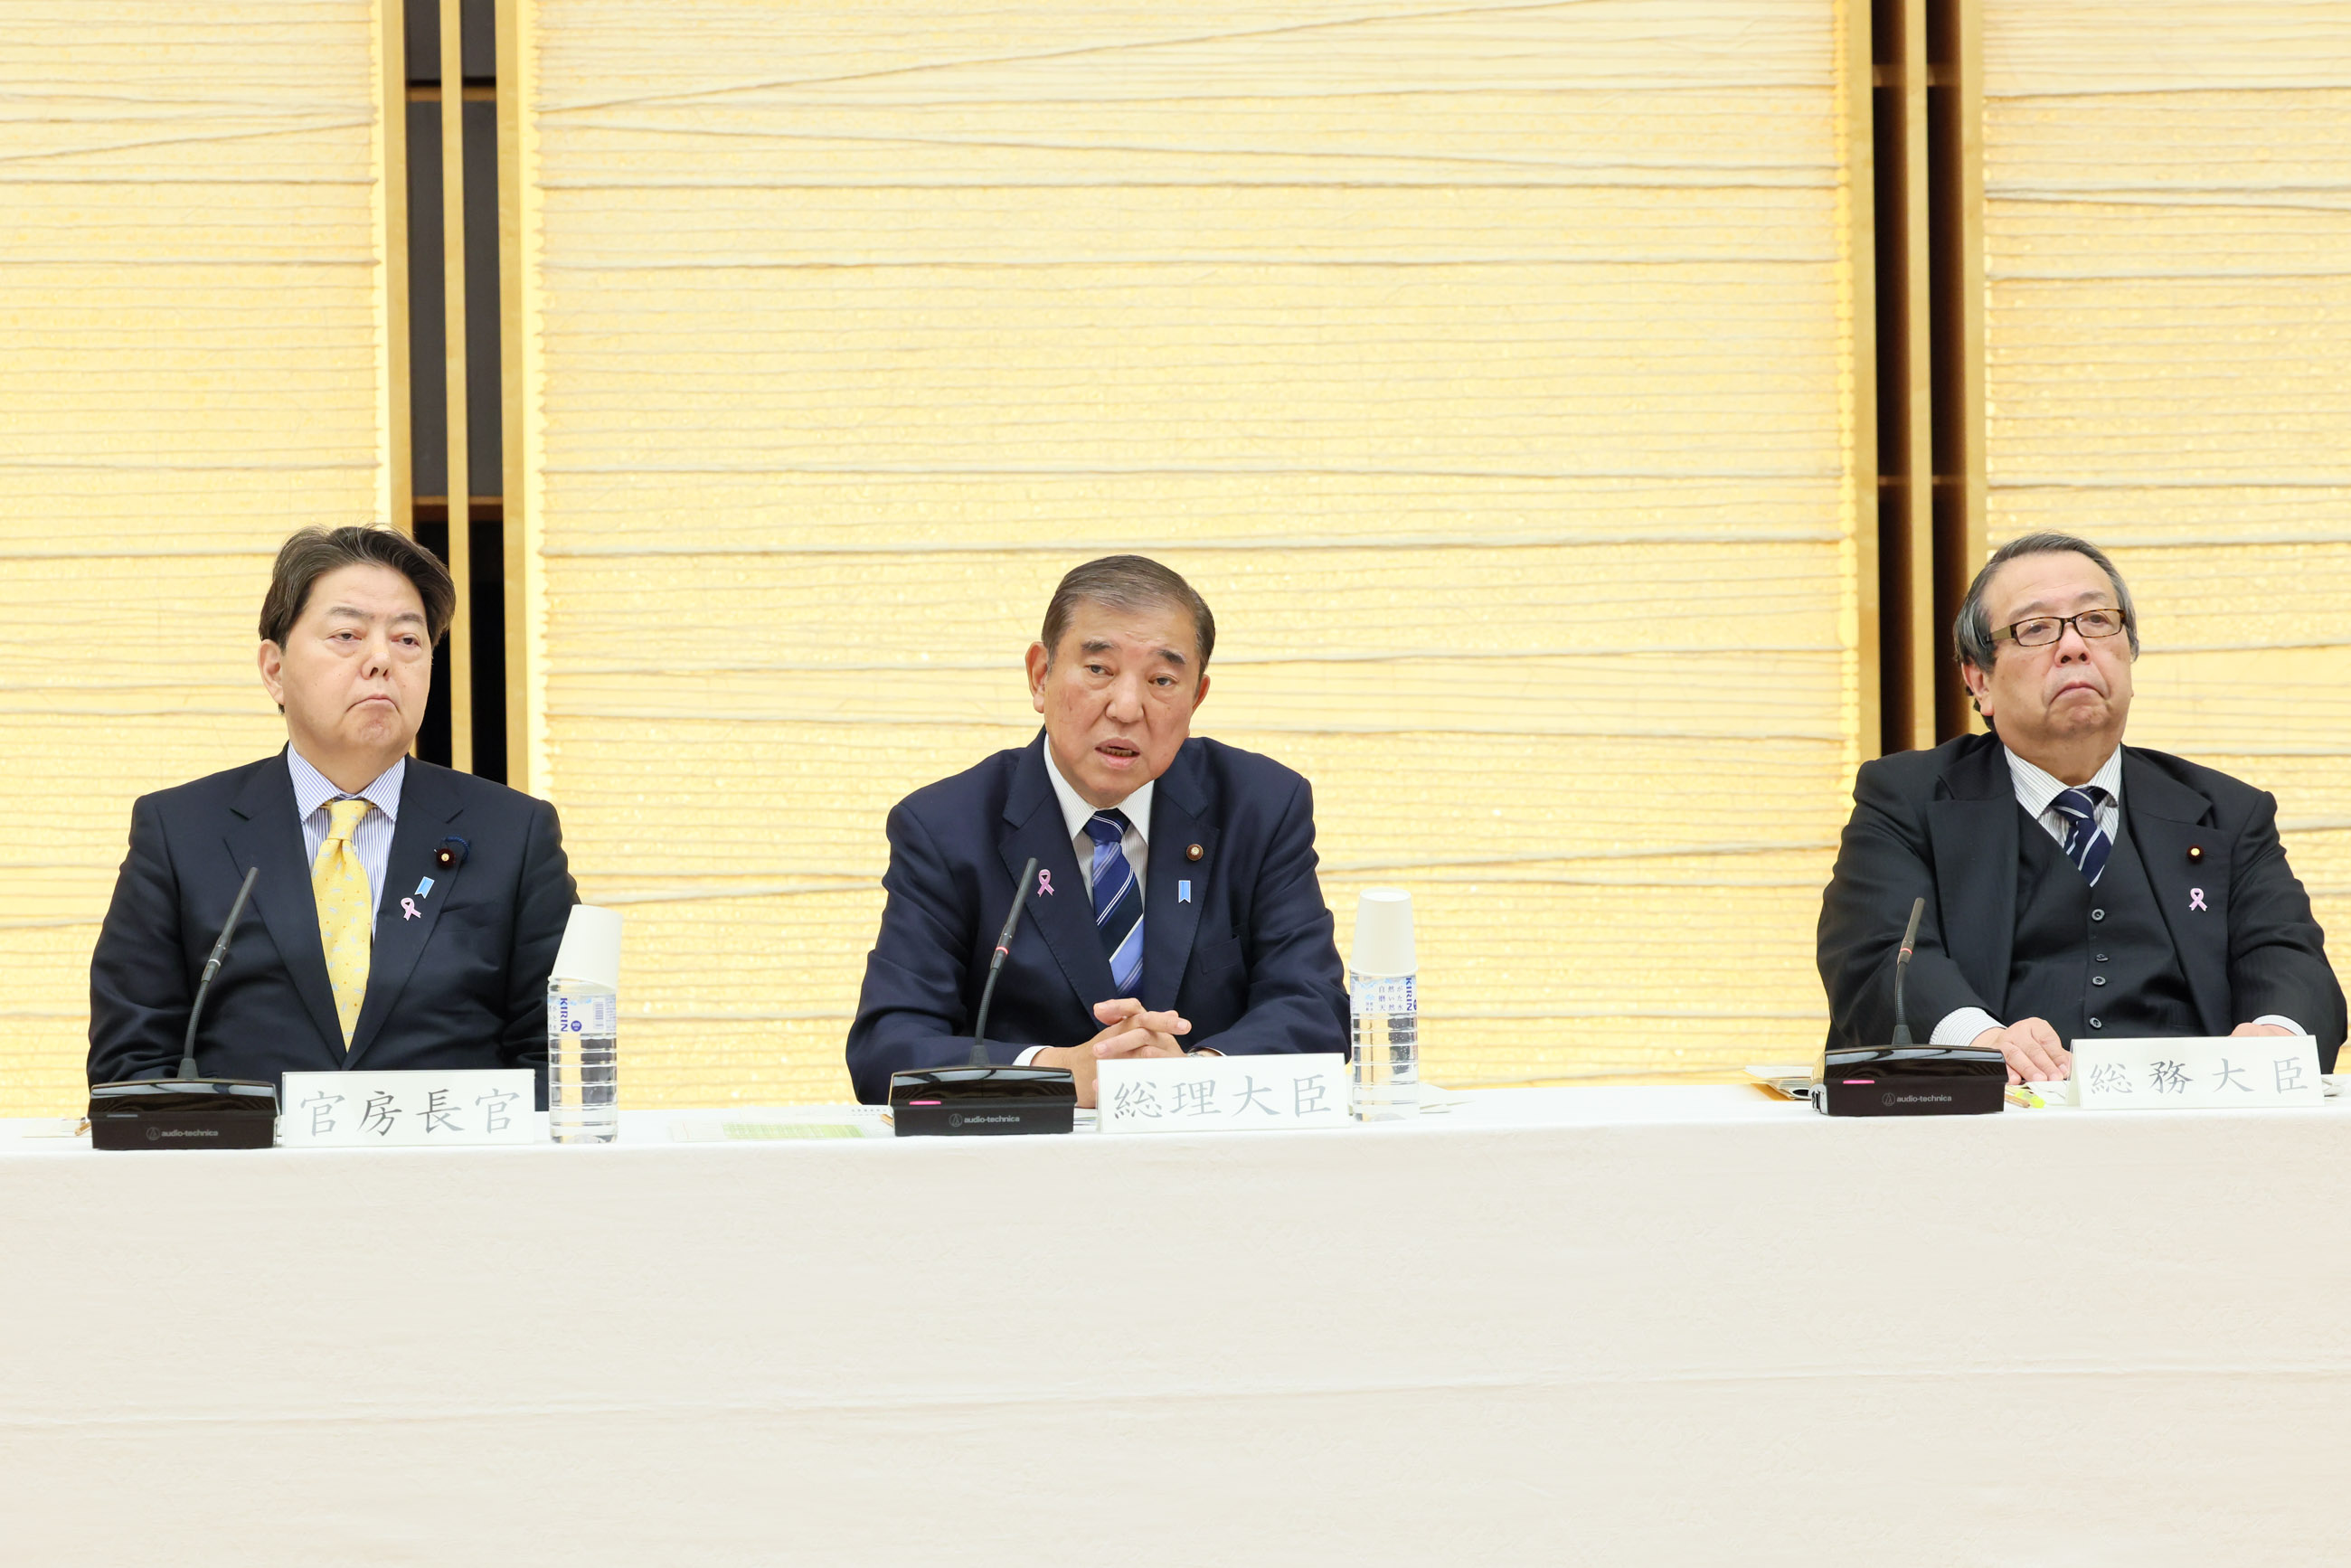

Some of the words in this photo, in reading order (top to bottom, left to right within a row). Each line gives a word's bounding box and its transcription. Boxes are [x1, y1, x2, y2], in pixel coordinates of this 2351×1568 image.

[560, 997, 568, 1032] KIRIN
[2090, 1056, 2309, 1095] 総務大臣
[300, 1088, 520, 1137] 官房長官
[1114, 1074, 1332, 1119] 総理大臣
[1896, 1094, 1952, 1102] audio-technica
[161, 1129, 219, 1137] audio-technica
[964, 1115, 1020, 1123] audio-technica
